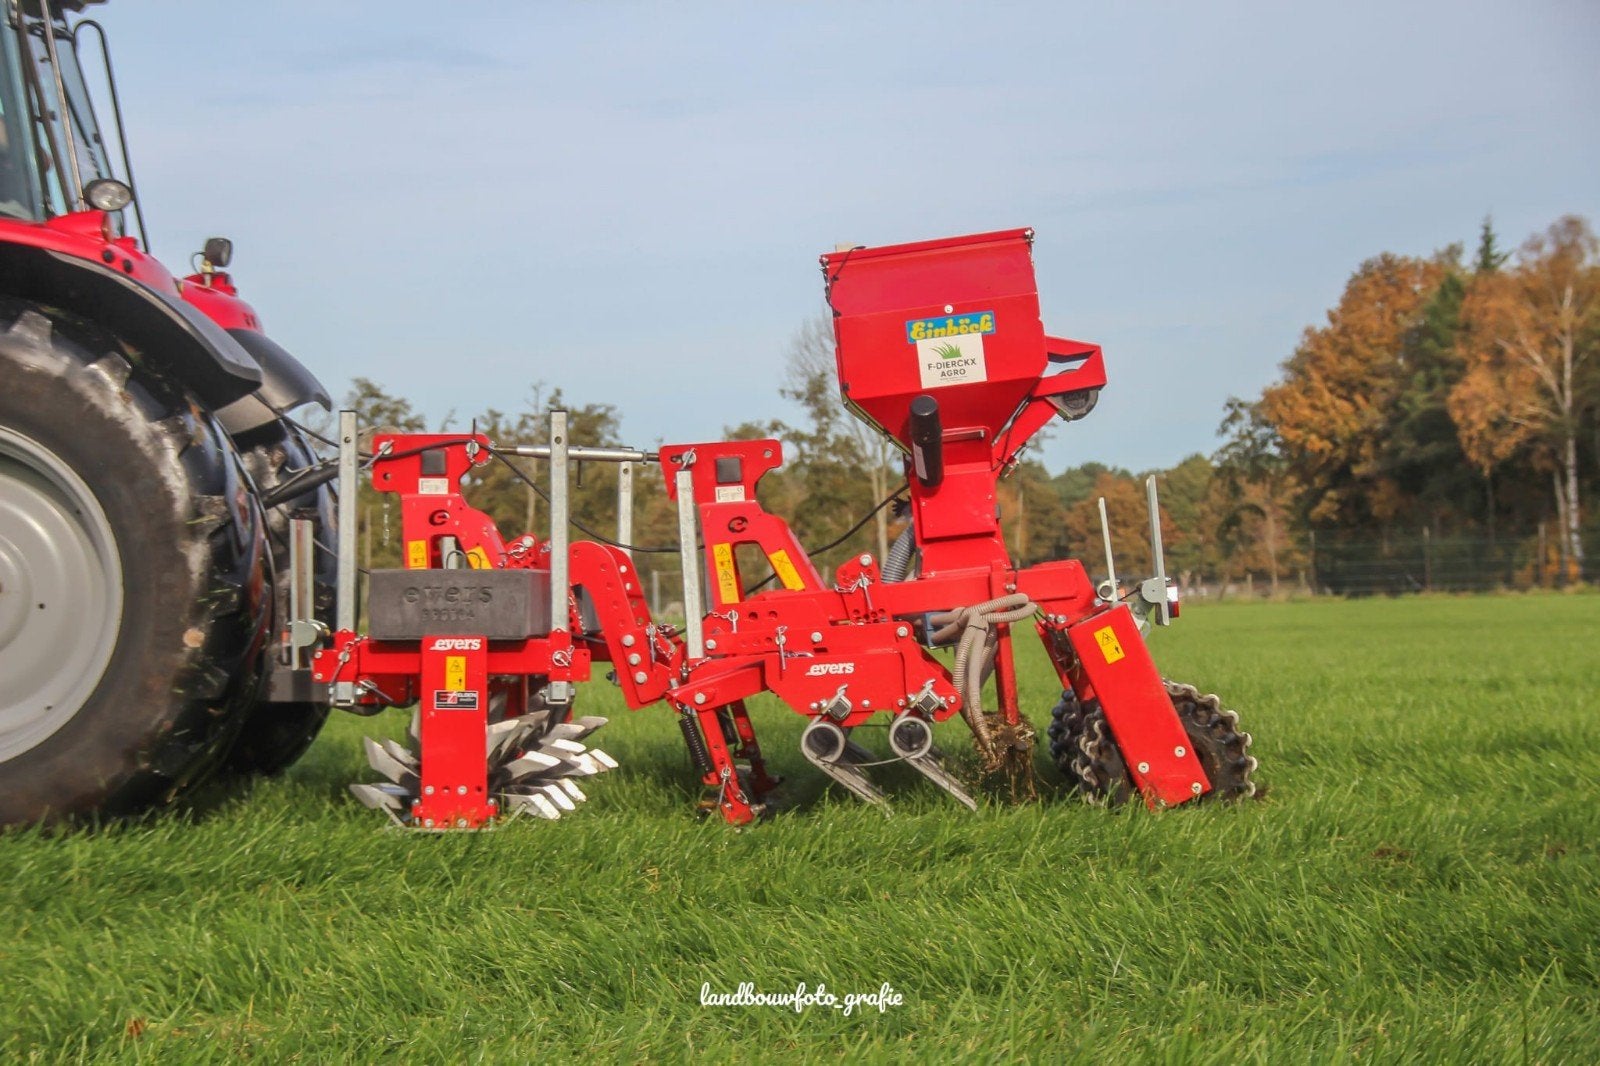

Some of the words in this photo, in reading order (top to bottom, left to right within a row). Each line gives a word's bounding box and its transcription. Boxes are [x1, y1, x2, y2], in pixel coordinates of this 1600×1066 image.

[910, 314, 992, 339] Einböck
[927, 358, 977, 371] F-DIERCKX
[940, 368, 966, 378] AGRO
[429, 638, 482, 651] evers
[804, 662, 855, 677] evers
